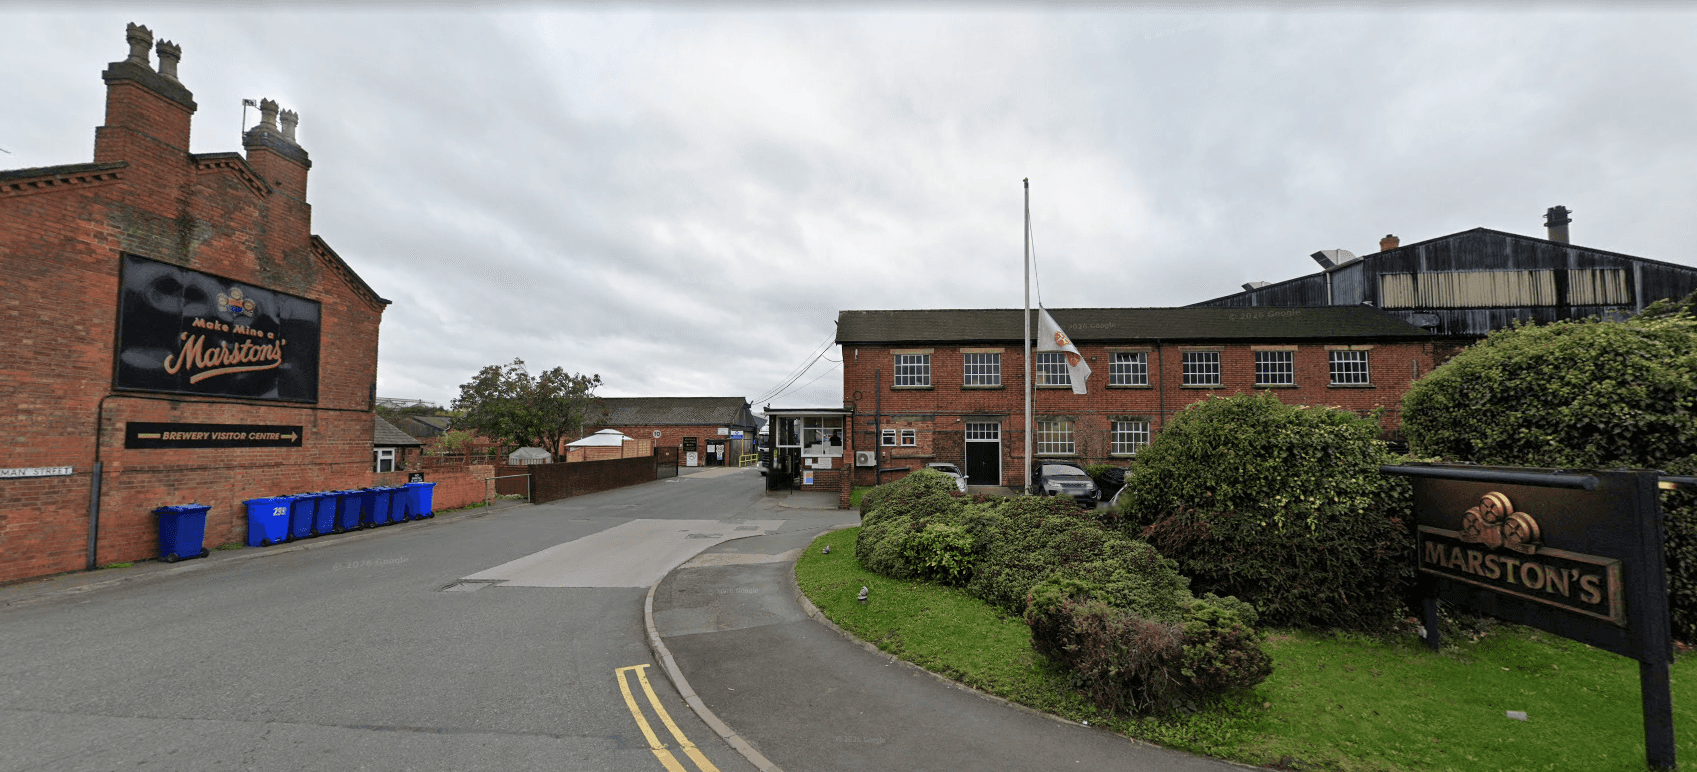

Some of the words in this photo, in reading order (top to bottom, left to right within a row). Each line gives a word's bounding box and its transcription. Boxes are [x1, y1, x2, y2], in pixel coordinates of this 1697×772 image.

[192, 317, 229, 332] Make
[233, 325, 264, 338] Mine
[163, 431, 210, 440] BREWERY
[211, 431, 247, 440] VISITOR
[249, 432, 280, 440] CENTRE
[33, 467, 69, 476] STREET
[1424, 540, 1602, 605] MARSTON'S
